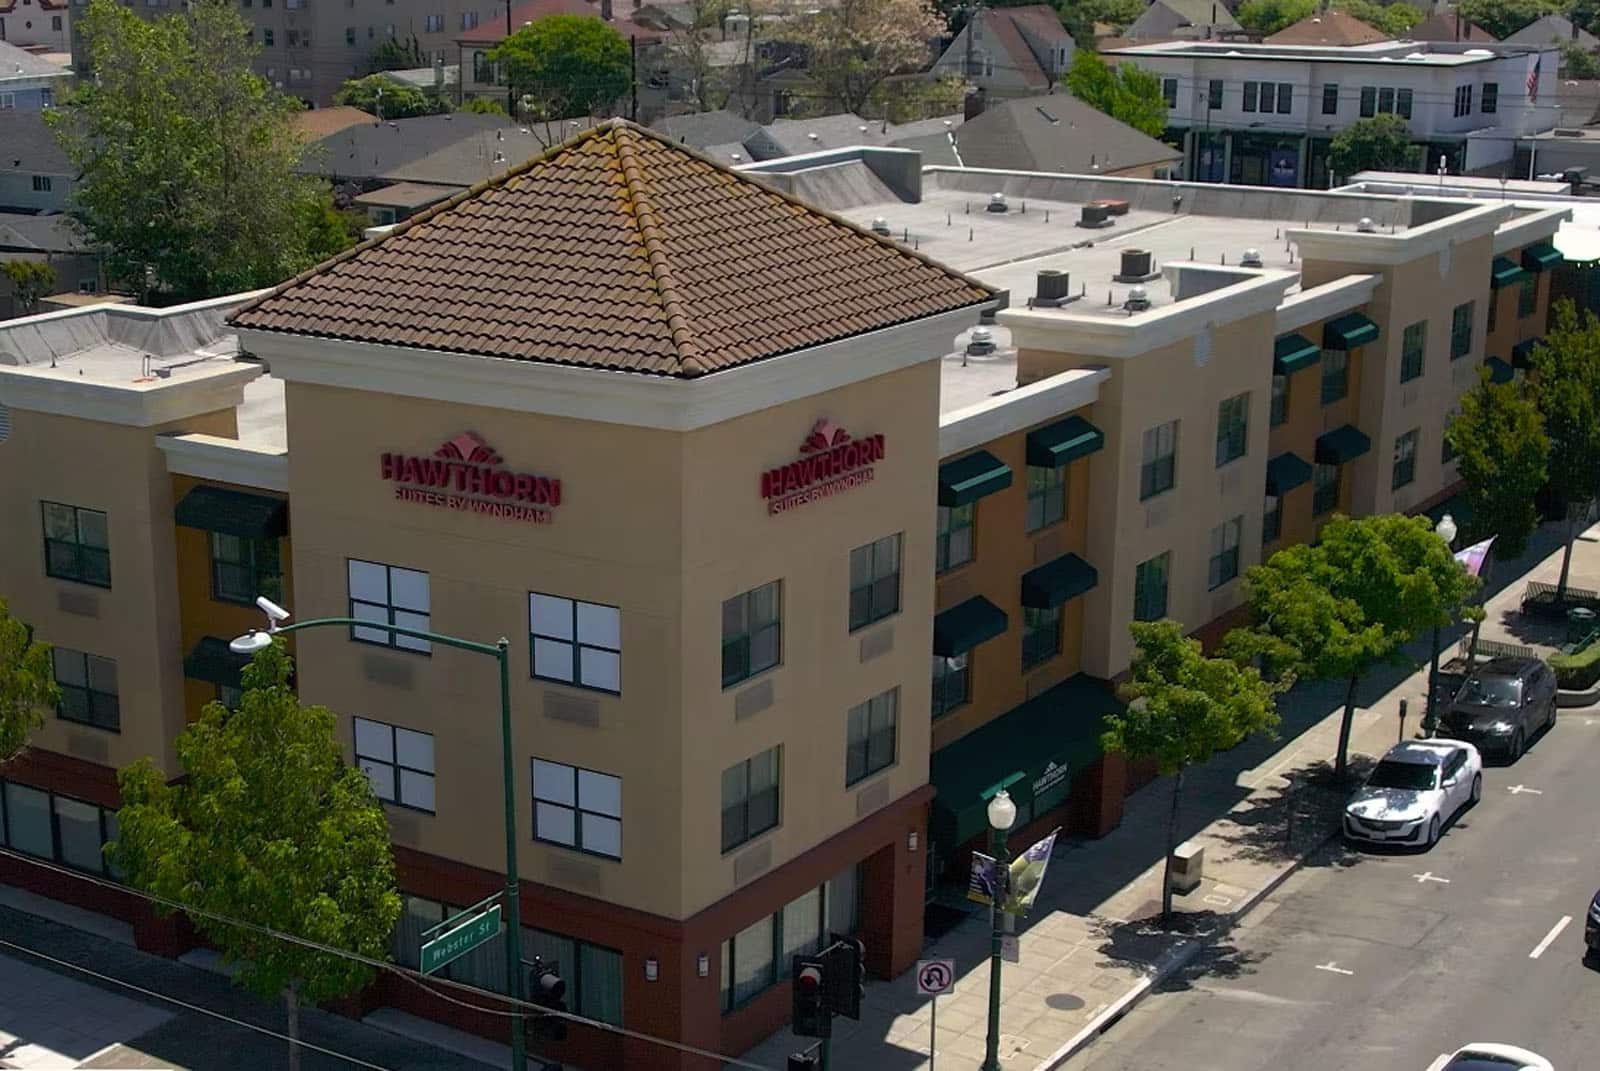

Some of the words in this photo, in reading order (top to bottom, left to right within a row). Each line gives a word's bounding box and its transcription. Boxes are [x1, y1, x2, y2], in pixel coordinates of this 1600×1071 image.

[381, 453, 562, 506] HAWTHORN
[759, 434, 884, 498] HAWTHORN
[395, 487, 446, 506] SUITES
[447, 497, 465, 512] BY
[469, 501, 552, 524] WYNDHAM
[770, 491, 811, 515] SUITES
[433, 932, 473, 961] Webster
[479, 922, 490, 935] St
